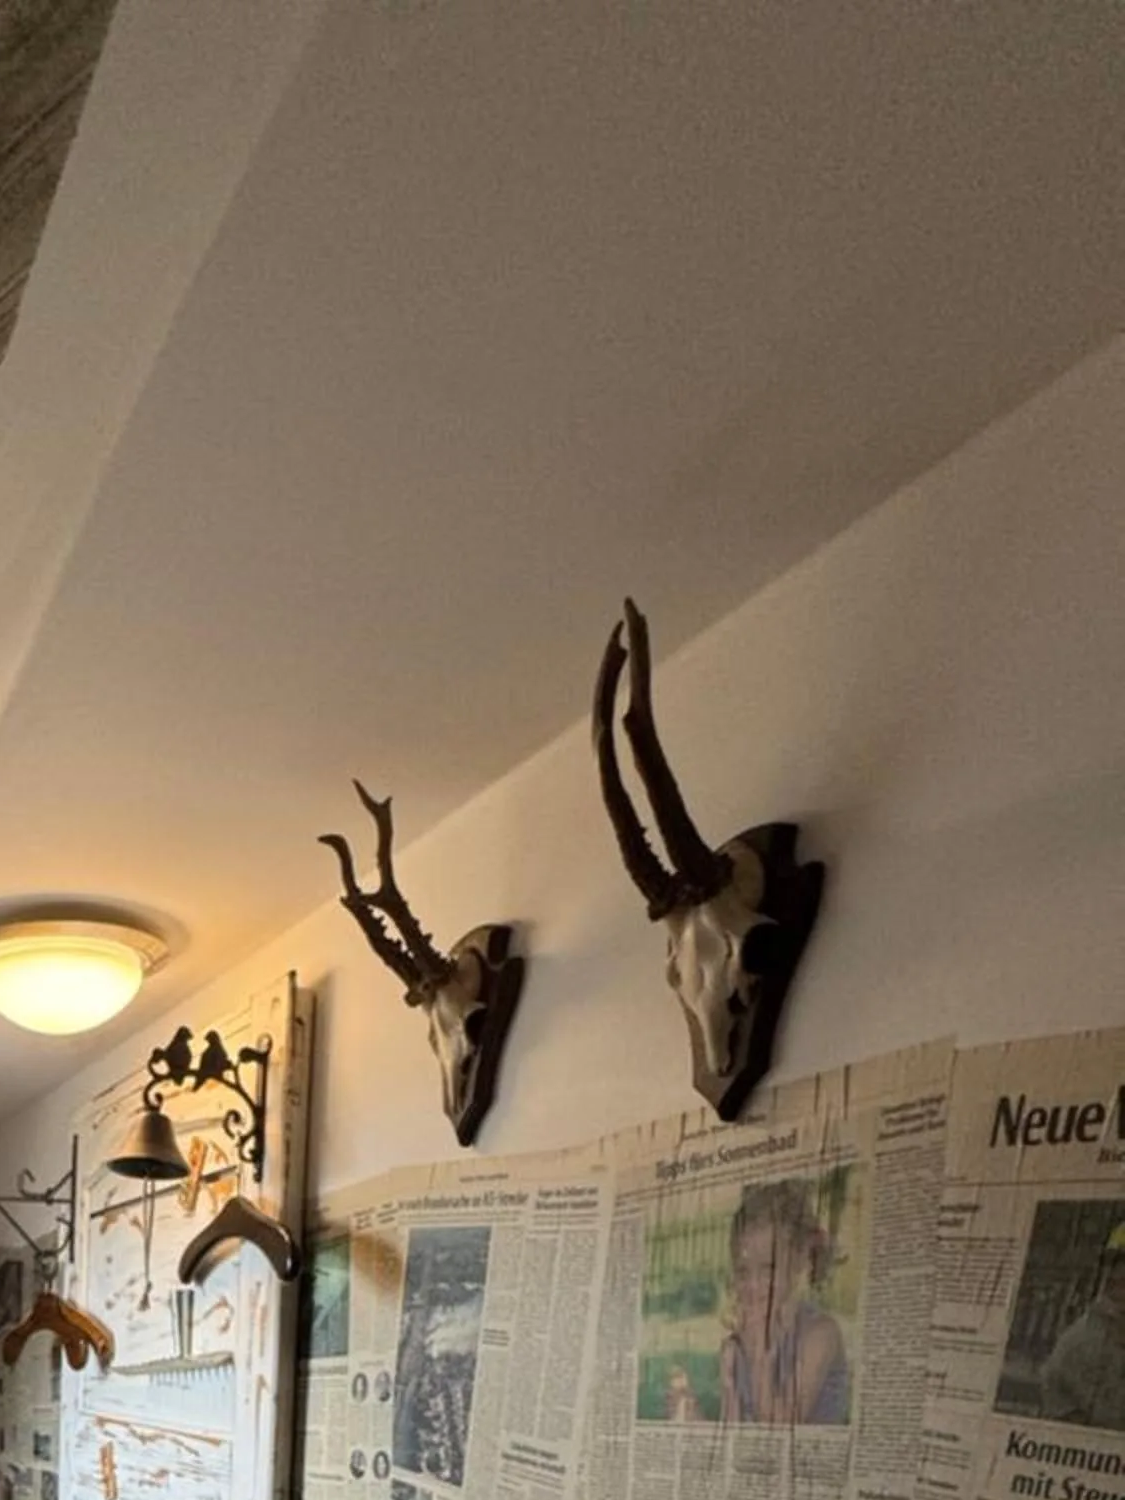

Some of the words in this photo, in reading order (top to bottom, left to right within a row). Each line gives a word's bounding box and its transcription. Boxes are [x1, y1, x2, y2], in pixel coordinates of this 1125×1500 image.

[989, 1093, 1106, 1148] Neue
[1005, 1429, 1125, 1476] Kommun
[1010, 1471, 1056, 1500] mit
